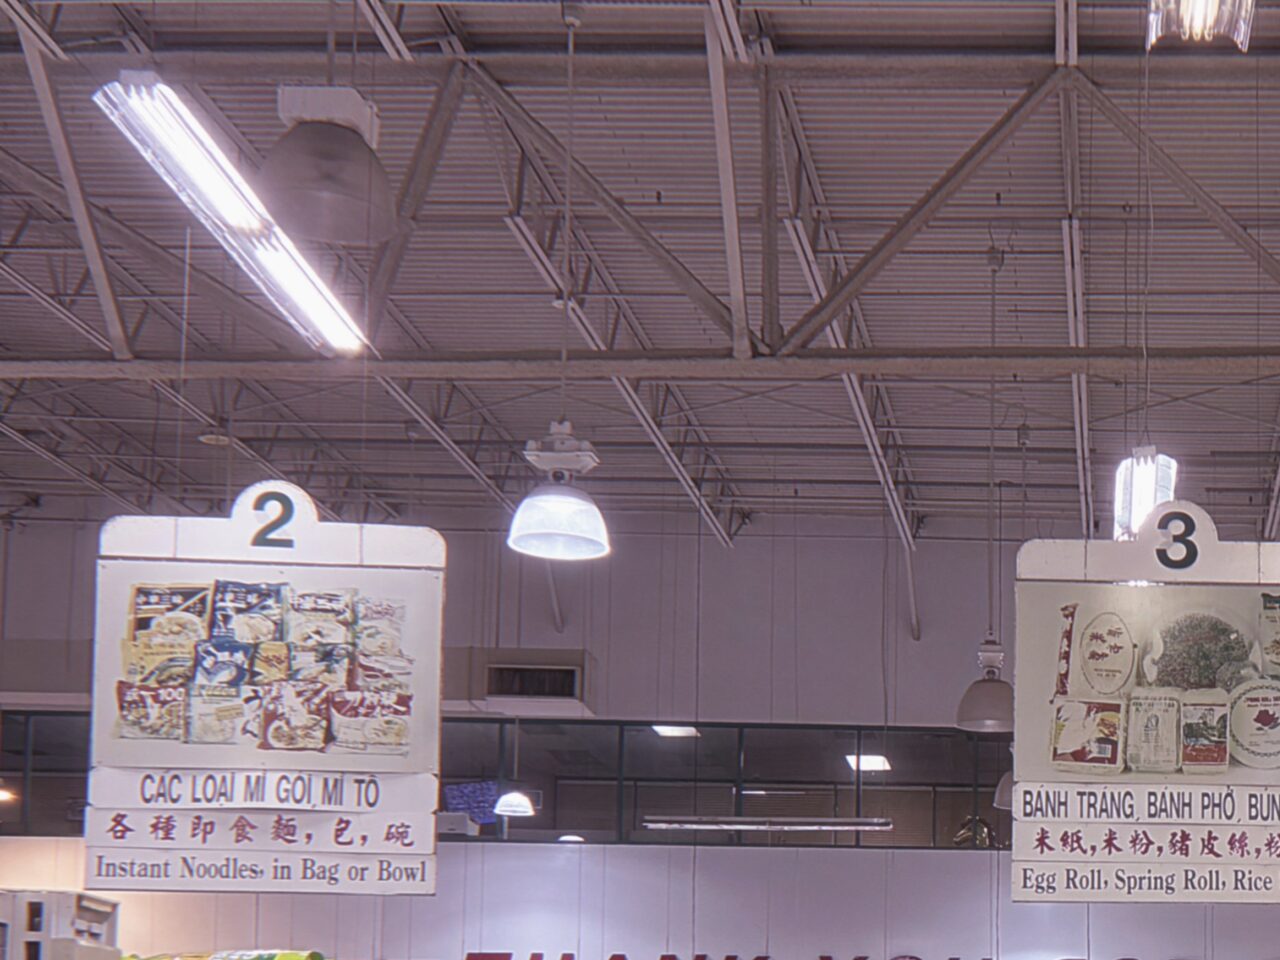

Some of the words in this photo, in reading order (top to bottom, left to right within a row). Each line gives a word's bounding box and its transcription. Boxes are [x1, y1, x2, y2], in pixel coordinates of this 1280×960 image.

[250, 491, 295, 549] 2
[1155, 511, 1199, 570] 3
[1022, 784, 1069, 819] BÁNH
[1147, 785, 1193, 820] BÁNH
[95, 854, 172, 878] Instant
[272, 857, 292, 881] in
[300, 858, 339, 886] Bag
[348, 862, 369, 882] or
[377, 859, 427, 882] Bowl
[1022, 867, 1057, 895] Egg
[1114, 869, 1176, 895] Spring
[1233, 870, 1273, 892] Rice
